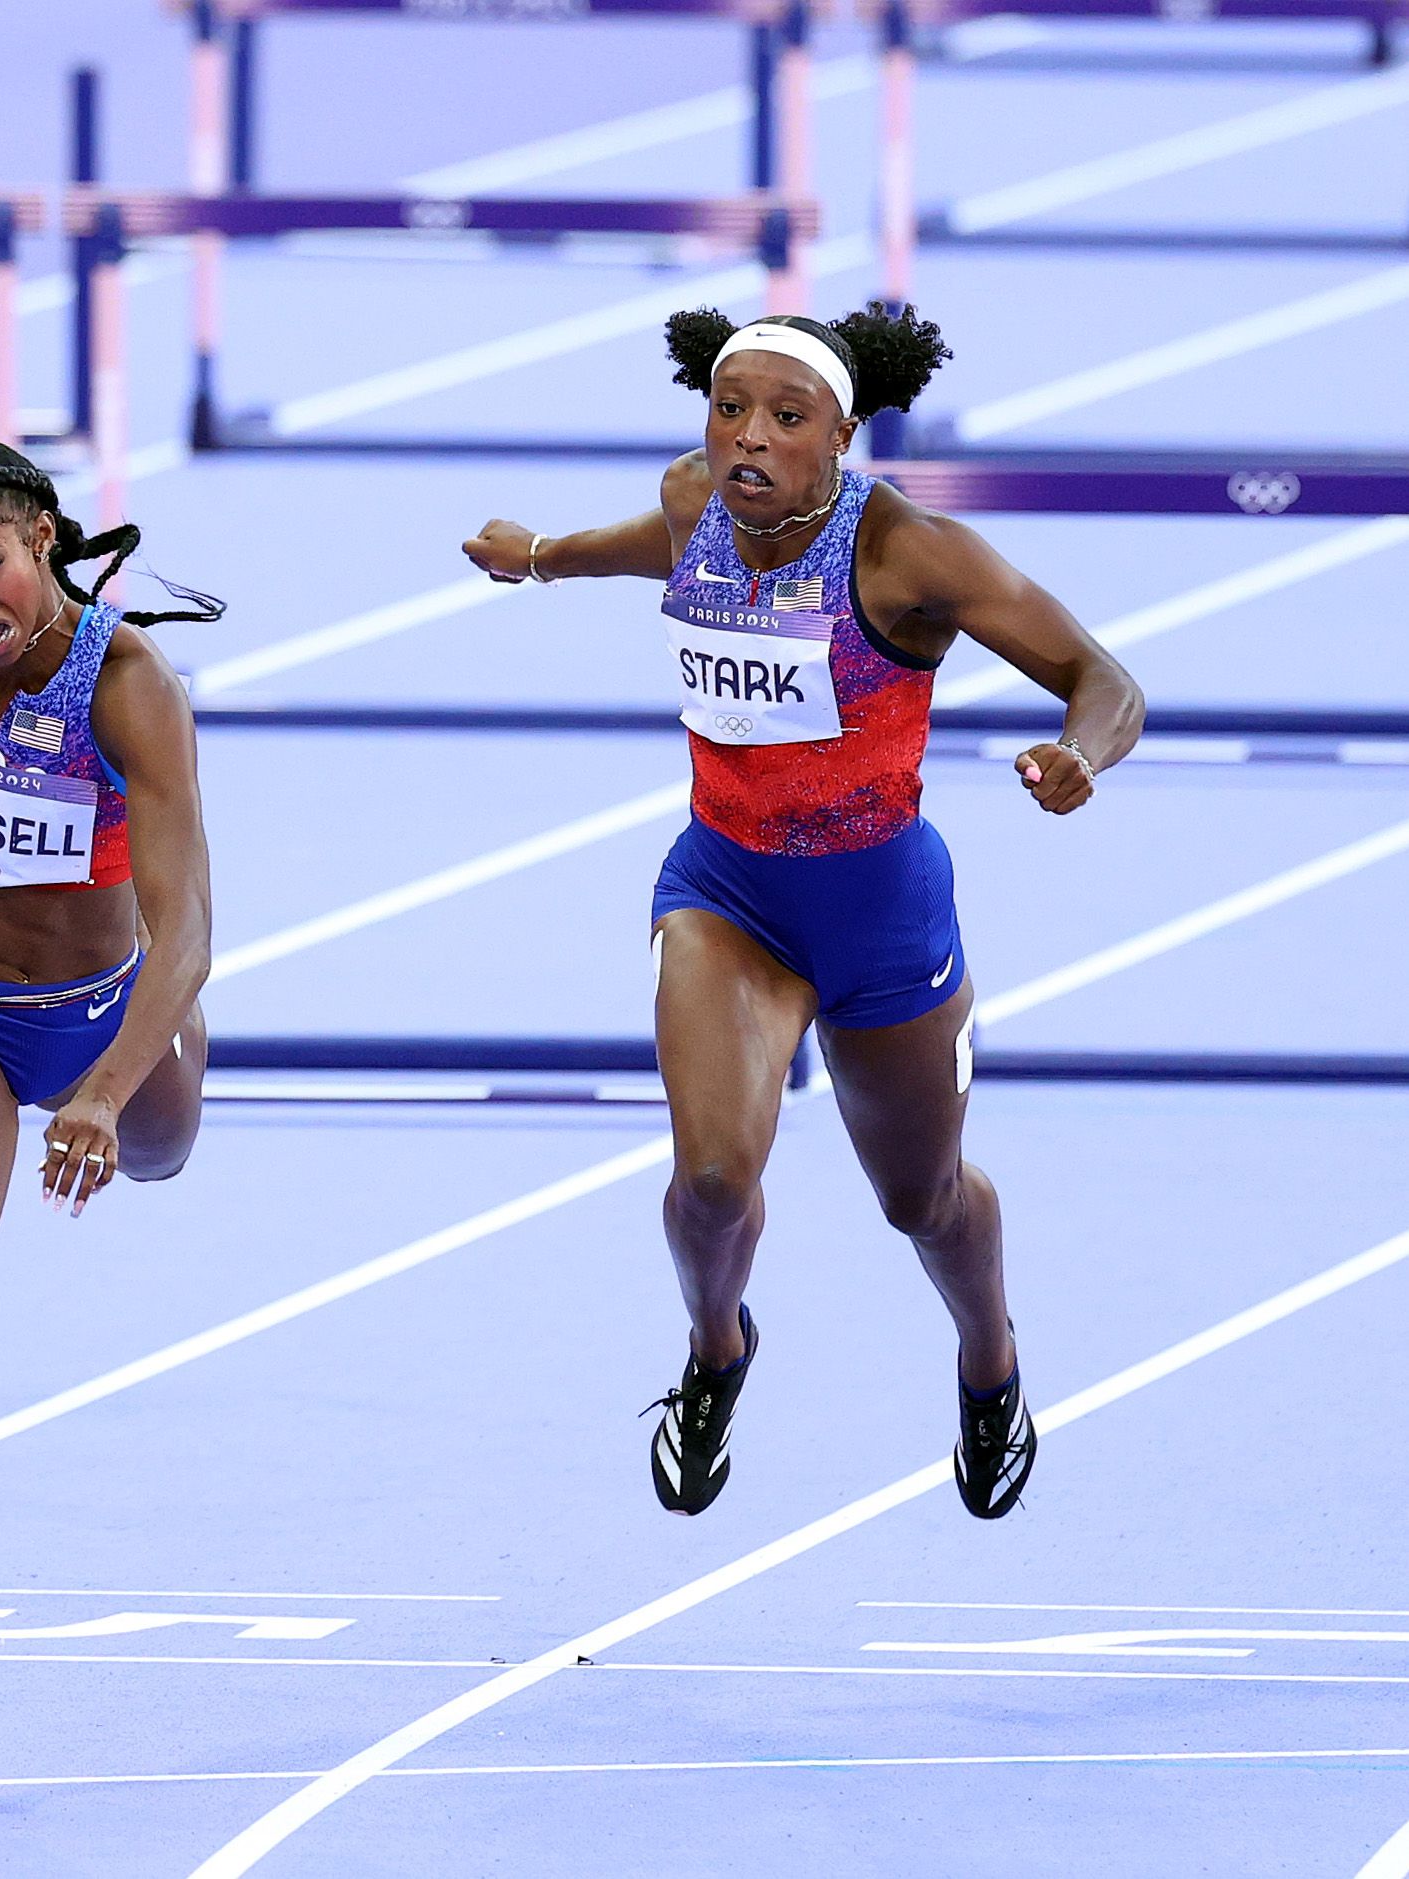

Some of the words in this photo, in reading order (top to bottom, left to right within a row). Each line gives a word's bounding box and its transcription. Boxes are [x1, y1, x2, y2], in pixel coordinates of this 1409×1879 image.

[688, 605, 731, 622] PARIS
[736, 614, 780, 630] 2024
[679, 648, 805, 704] STARK
